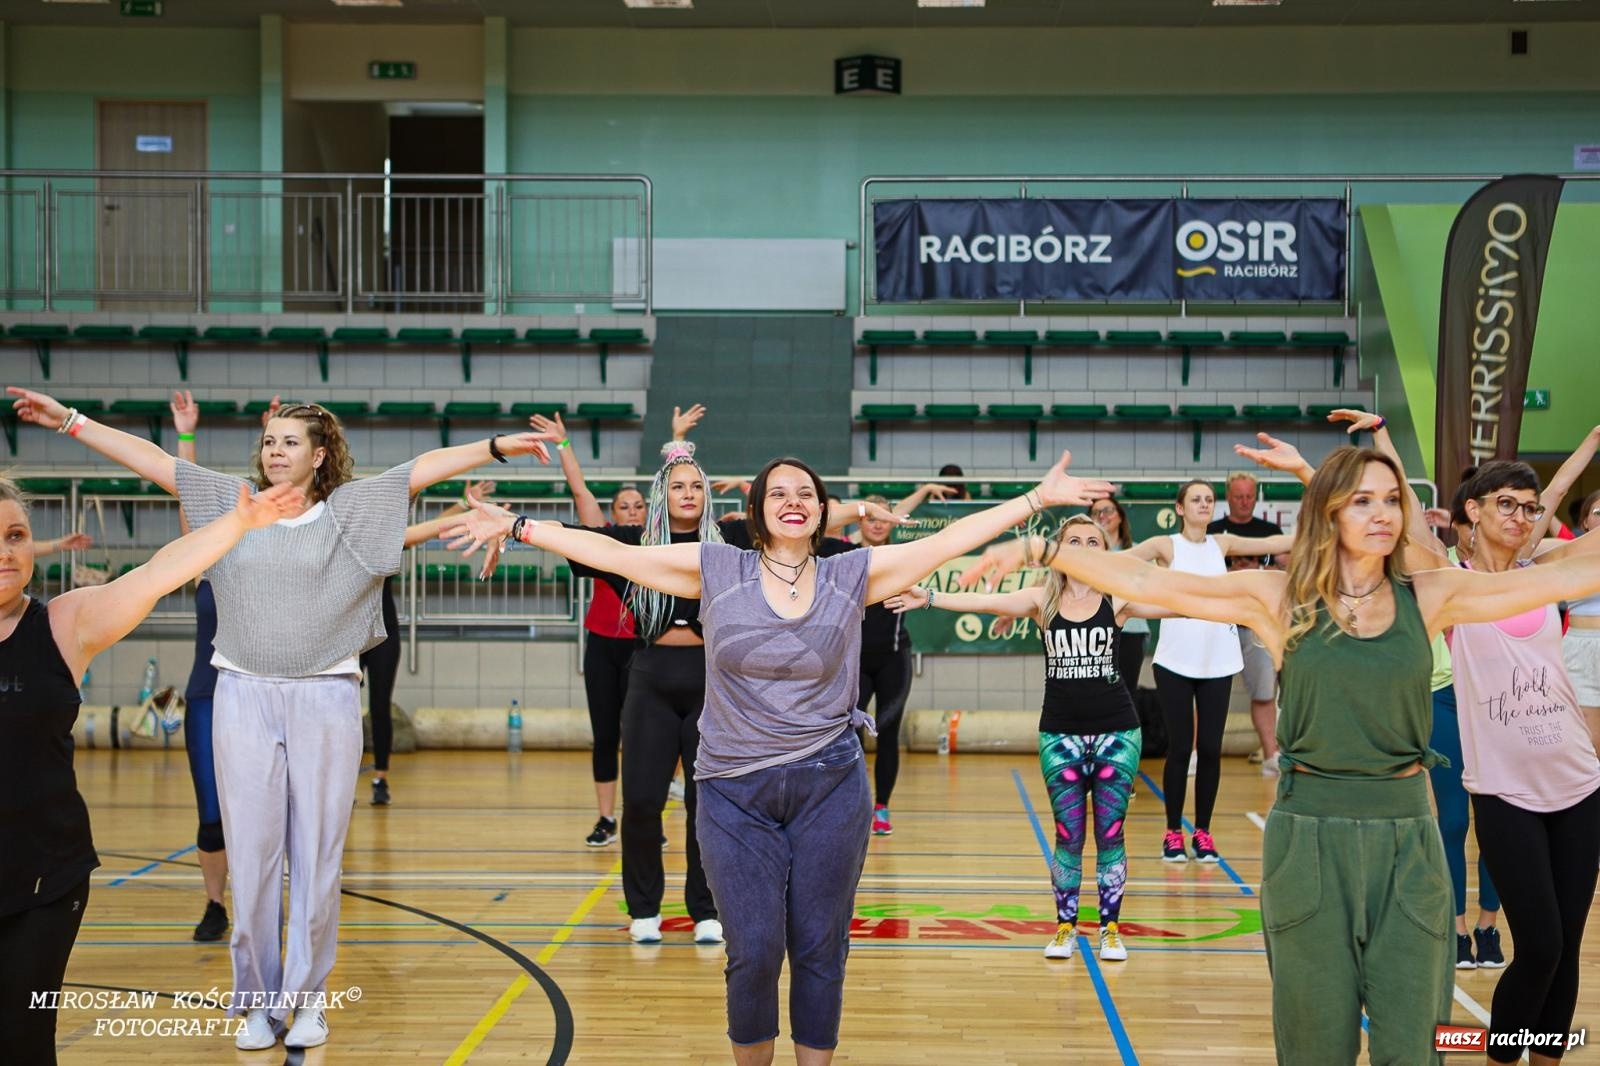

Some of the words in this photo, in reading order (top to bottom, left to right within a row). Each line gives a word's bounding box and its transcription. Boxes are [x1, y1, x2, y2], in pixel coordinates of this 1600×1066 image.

[843, 68, 859, 90] E
[876, 68, 894, 89] E
[919, 225, 1112, 264] RACIBÓRZ
[1224, 264, 1298, 278] RACIBÓRZ
[1045, 627, 1114, 657] DANCE
[1056, 665, 1100, 679] DEFINES
[1062, 658, 1079, 666] JUST
[1081, 657, 1093, 665] MY
[1512, 665, 1551, 701] hold
[1477, 691, 1521, 726] the
[1526, 703, 1566, 716] vision
[1519, 725, 1545, 736] TRUST
[1548, 720, 1562, 731] THE
[1527, 732, 1563, 746] PROCESS
